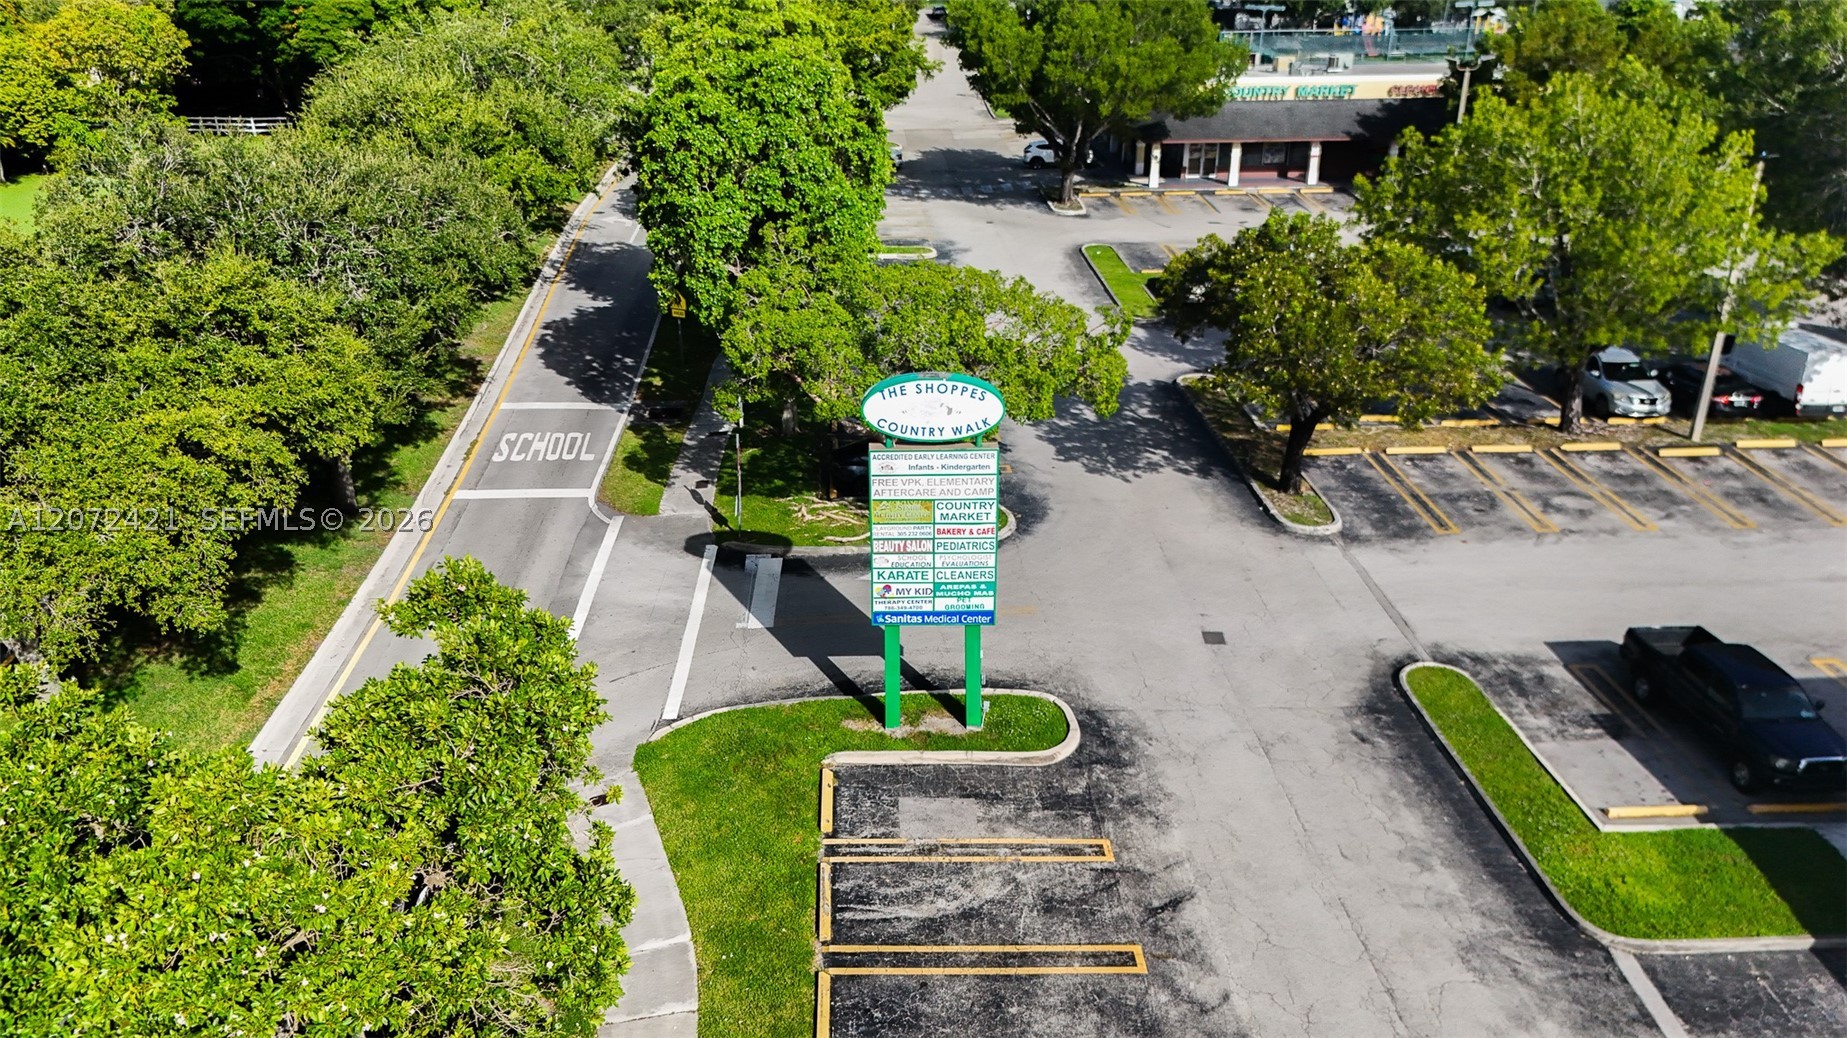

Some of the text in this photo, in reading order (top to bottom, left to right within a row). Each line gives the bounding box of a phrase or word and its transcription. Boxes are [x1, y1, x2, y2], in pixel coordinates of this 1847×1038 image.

[1296, 85, 1357, 97] MARKET
[879, 383, 987, 401] THE SHOPPES
[877, 418, 991, 437] COUNTRY WALK
[492, 432, 595, 462] SCHOOL
[927, 478, 995, 486] ELEMENTARY
[874, 489, 936, 497] AFTERCARE
[964, 488, 994, 496] CAMP
[937, 502, 995, 510] COUNTRY
[940, 512, 991, 521] MARKET
[978, 527, 995, 535] CAFÉ
[874, 540, 932, 552] BEAUTY SALON
[937, 542, 995, 551] PEDIATRICS
[877, 571, 929, 580] KARATE
[937, 571, 993, 580] CLEANERS
